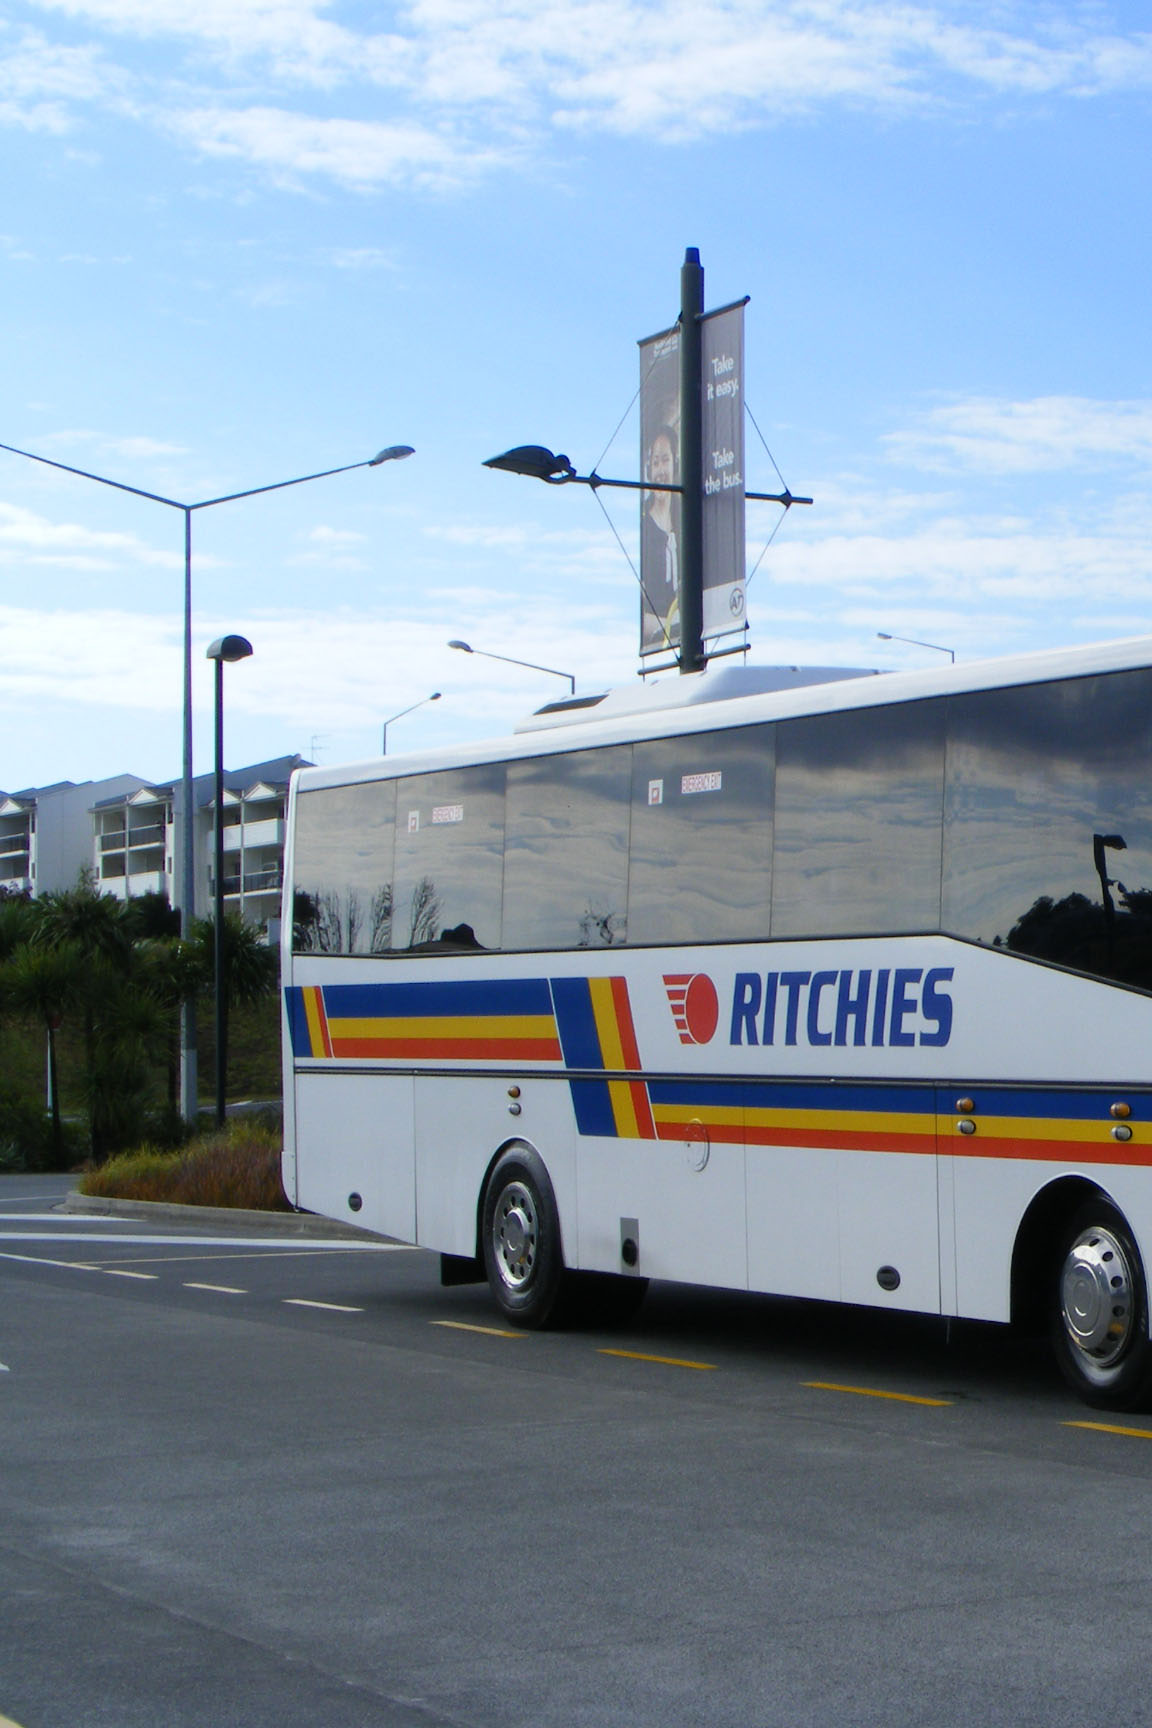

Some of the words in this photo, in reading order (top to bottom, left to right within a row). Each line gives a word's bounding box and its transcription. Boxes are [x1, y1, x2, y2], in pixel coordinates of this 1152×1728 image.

[712, 354, 734, 377] Take
[707, 383, 714, 401] it
[716, 378, 739, 398] easy.
[712, 447, 734, 470] Take
[705, 474, 721, 495] the
[723, 470, 743, 489] bus.
[729, 967, 955, 1047] RITCHIES
